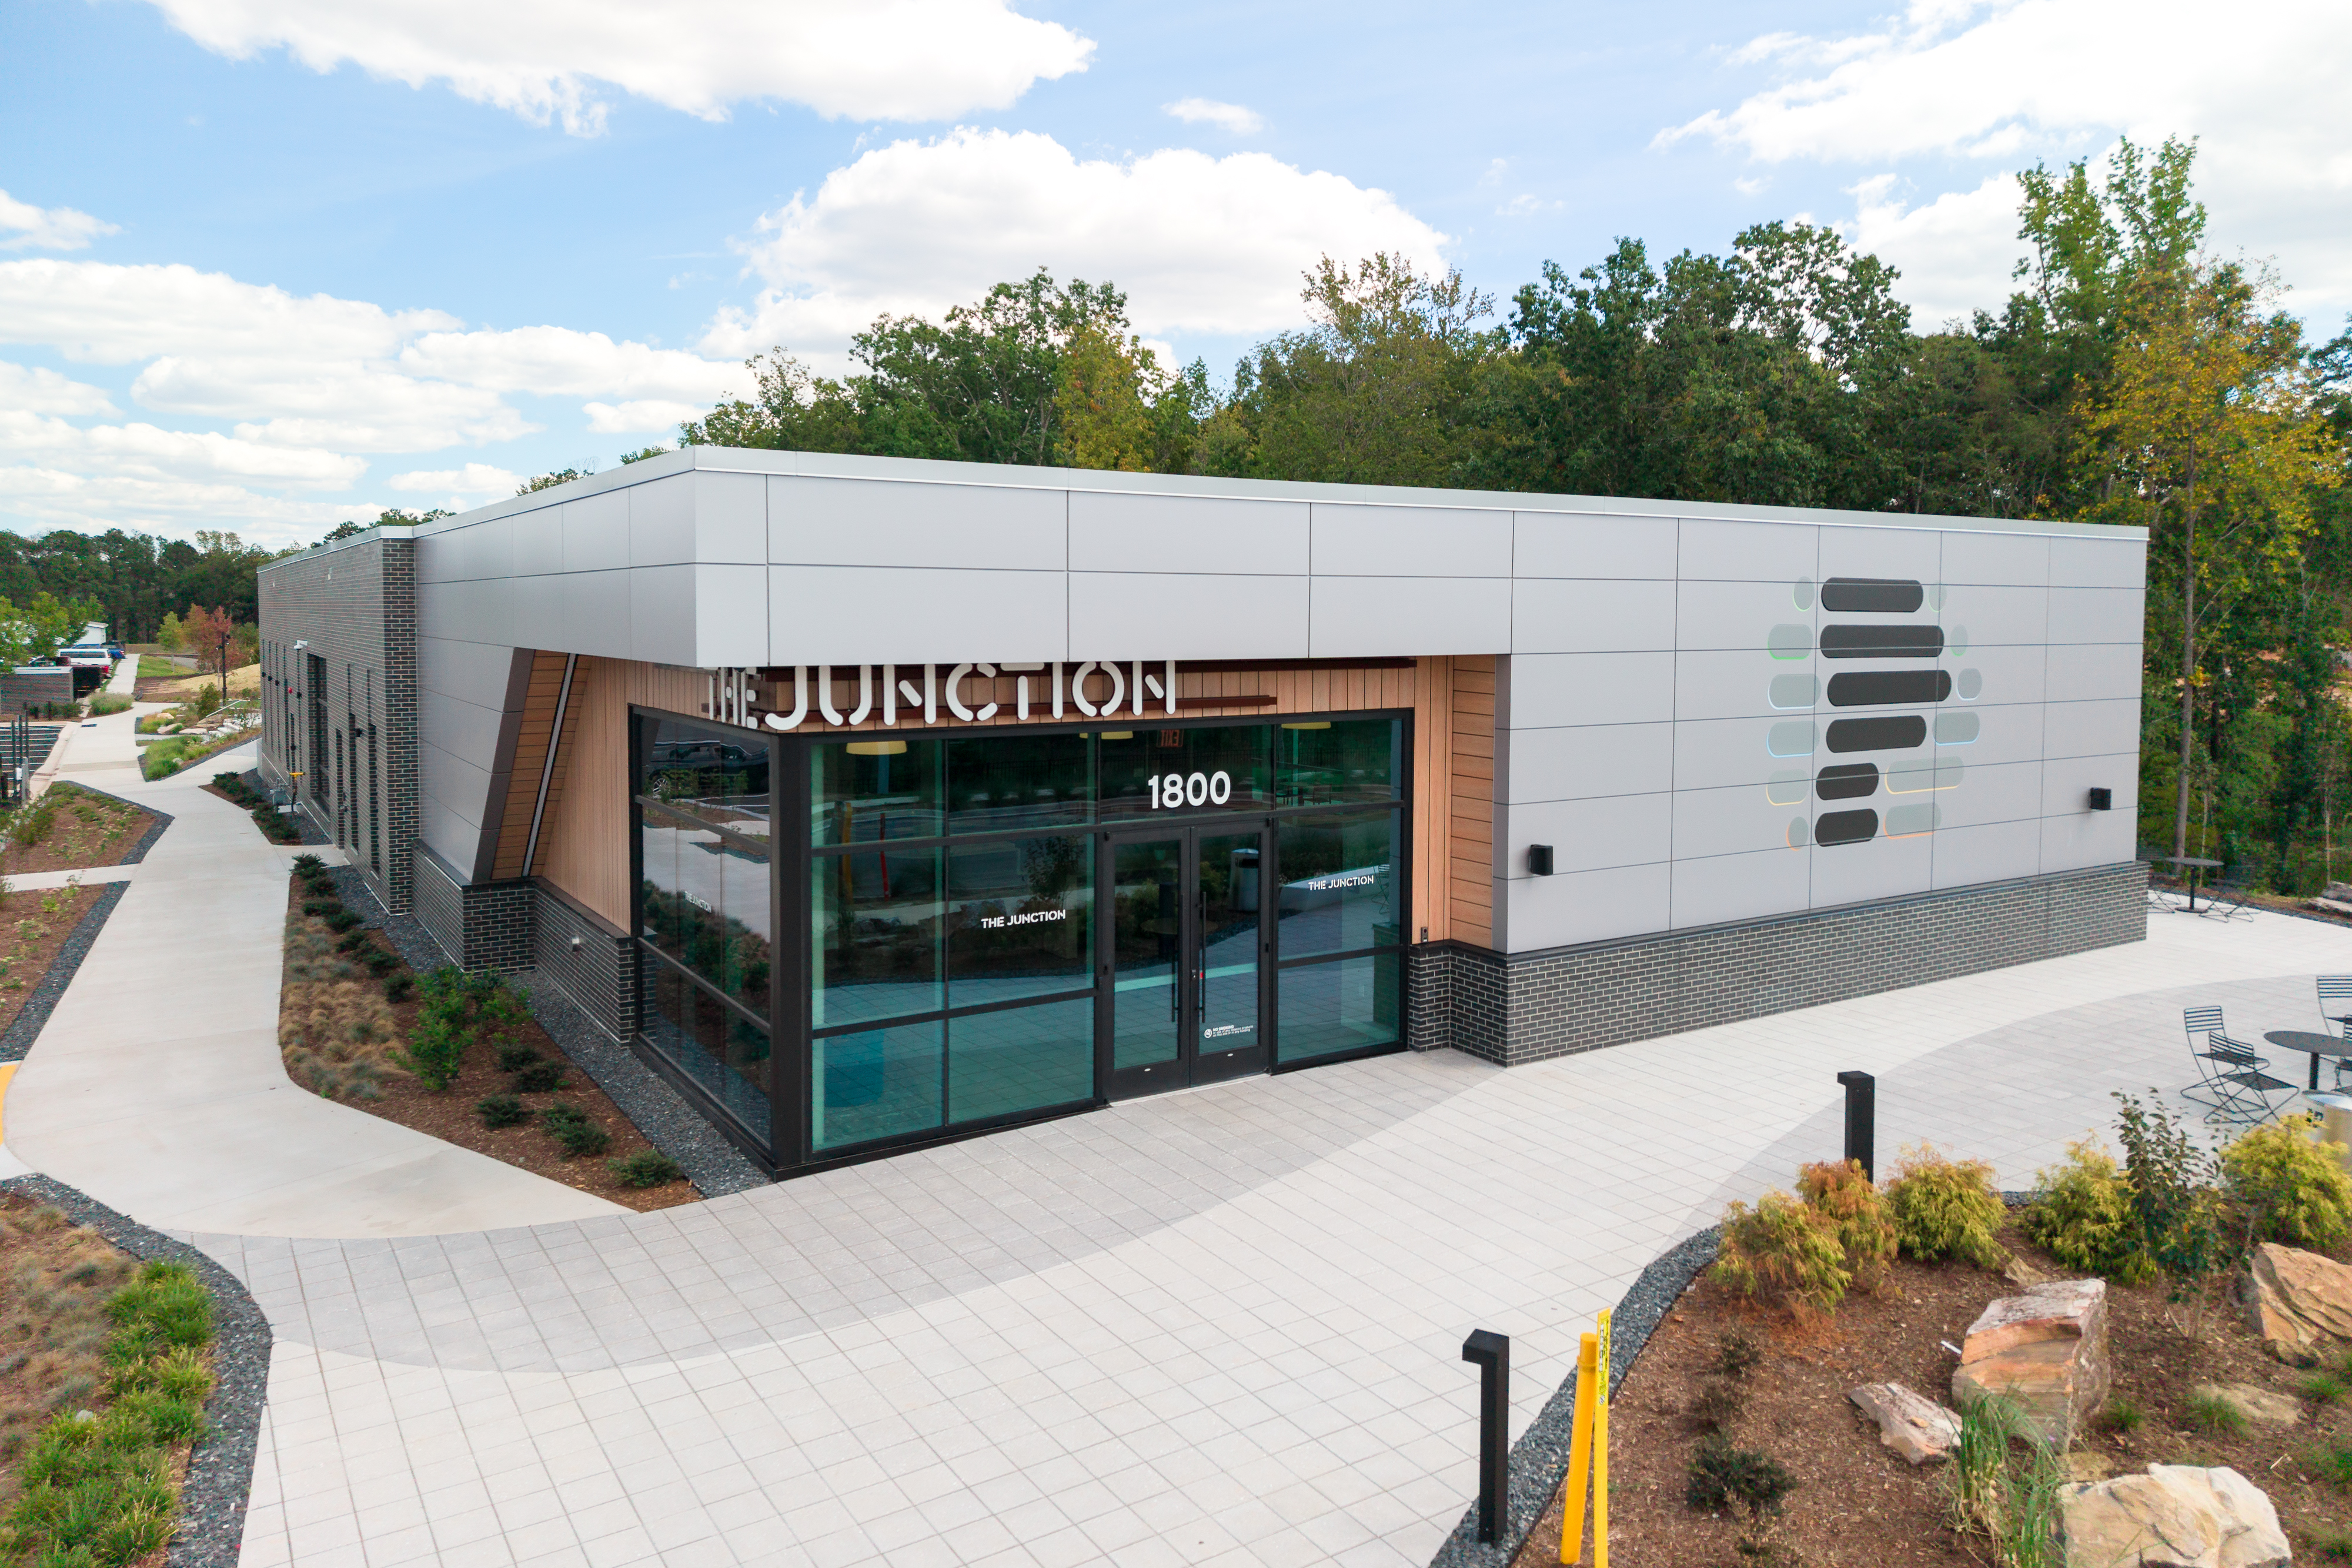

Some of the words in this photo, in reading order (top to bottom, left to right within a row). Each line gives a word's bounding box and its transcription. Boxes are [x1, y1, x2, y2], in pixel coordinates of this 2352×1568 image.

[765, 660, 1176, 730] JUNCTION
[1148, 771, 1231, 809] 1800
[1308, 880, 1327, 891] THE
[1328, 875, 1374, 889] JUNCTION
[981, 916, 1005, 929] THE
[1007, 909, 1066, 926] JUNCTION
